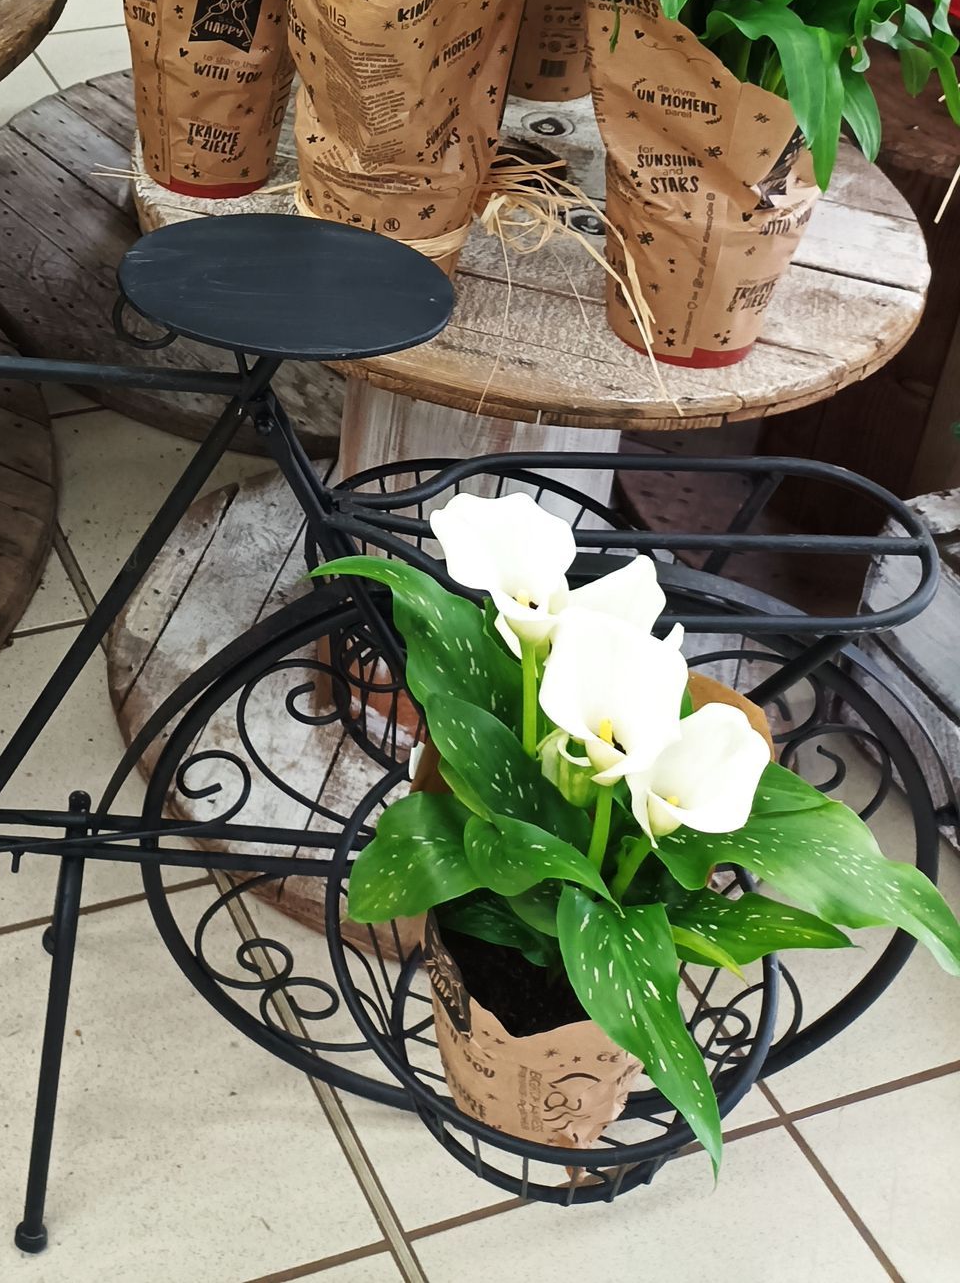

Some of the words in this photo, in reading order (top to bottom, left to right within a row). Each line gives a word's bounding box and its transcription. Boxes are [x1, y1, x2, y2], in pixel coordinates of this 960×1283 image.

[204, 20, 245, 37] HAPPY
[443, 27, 483, 62] MOMENT
[193, 62, 230, 82] WITH
[236, 71, 263, 84] YOU
[657, 84, 670, 93] de
[672, 87, 697, 98] vivre
[637, 89, 656, 104] UN
[661, 94, 719, 116] MOMENT
[200, 138, 238, 156] ZIELE
[638, 144, 656, 154] for
[637, 153, 705, 169] SUNSHINE
[663, 166, 684, 176] and
[650, 175, 700, 195] STARS
